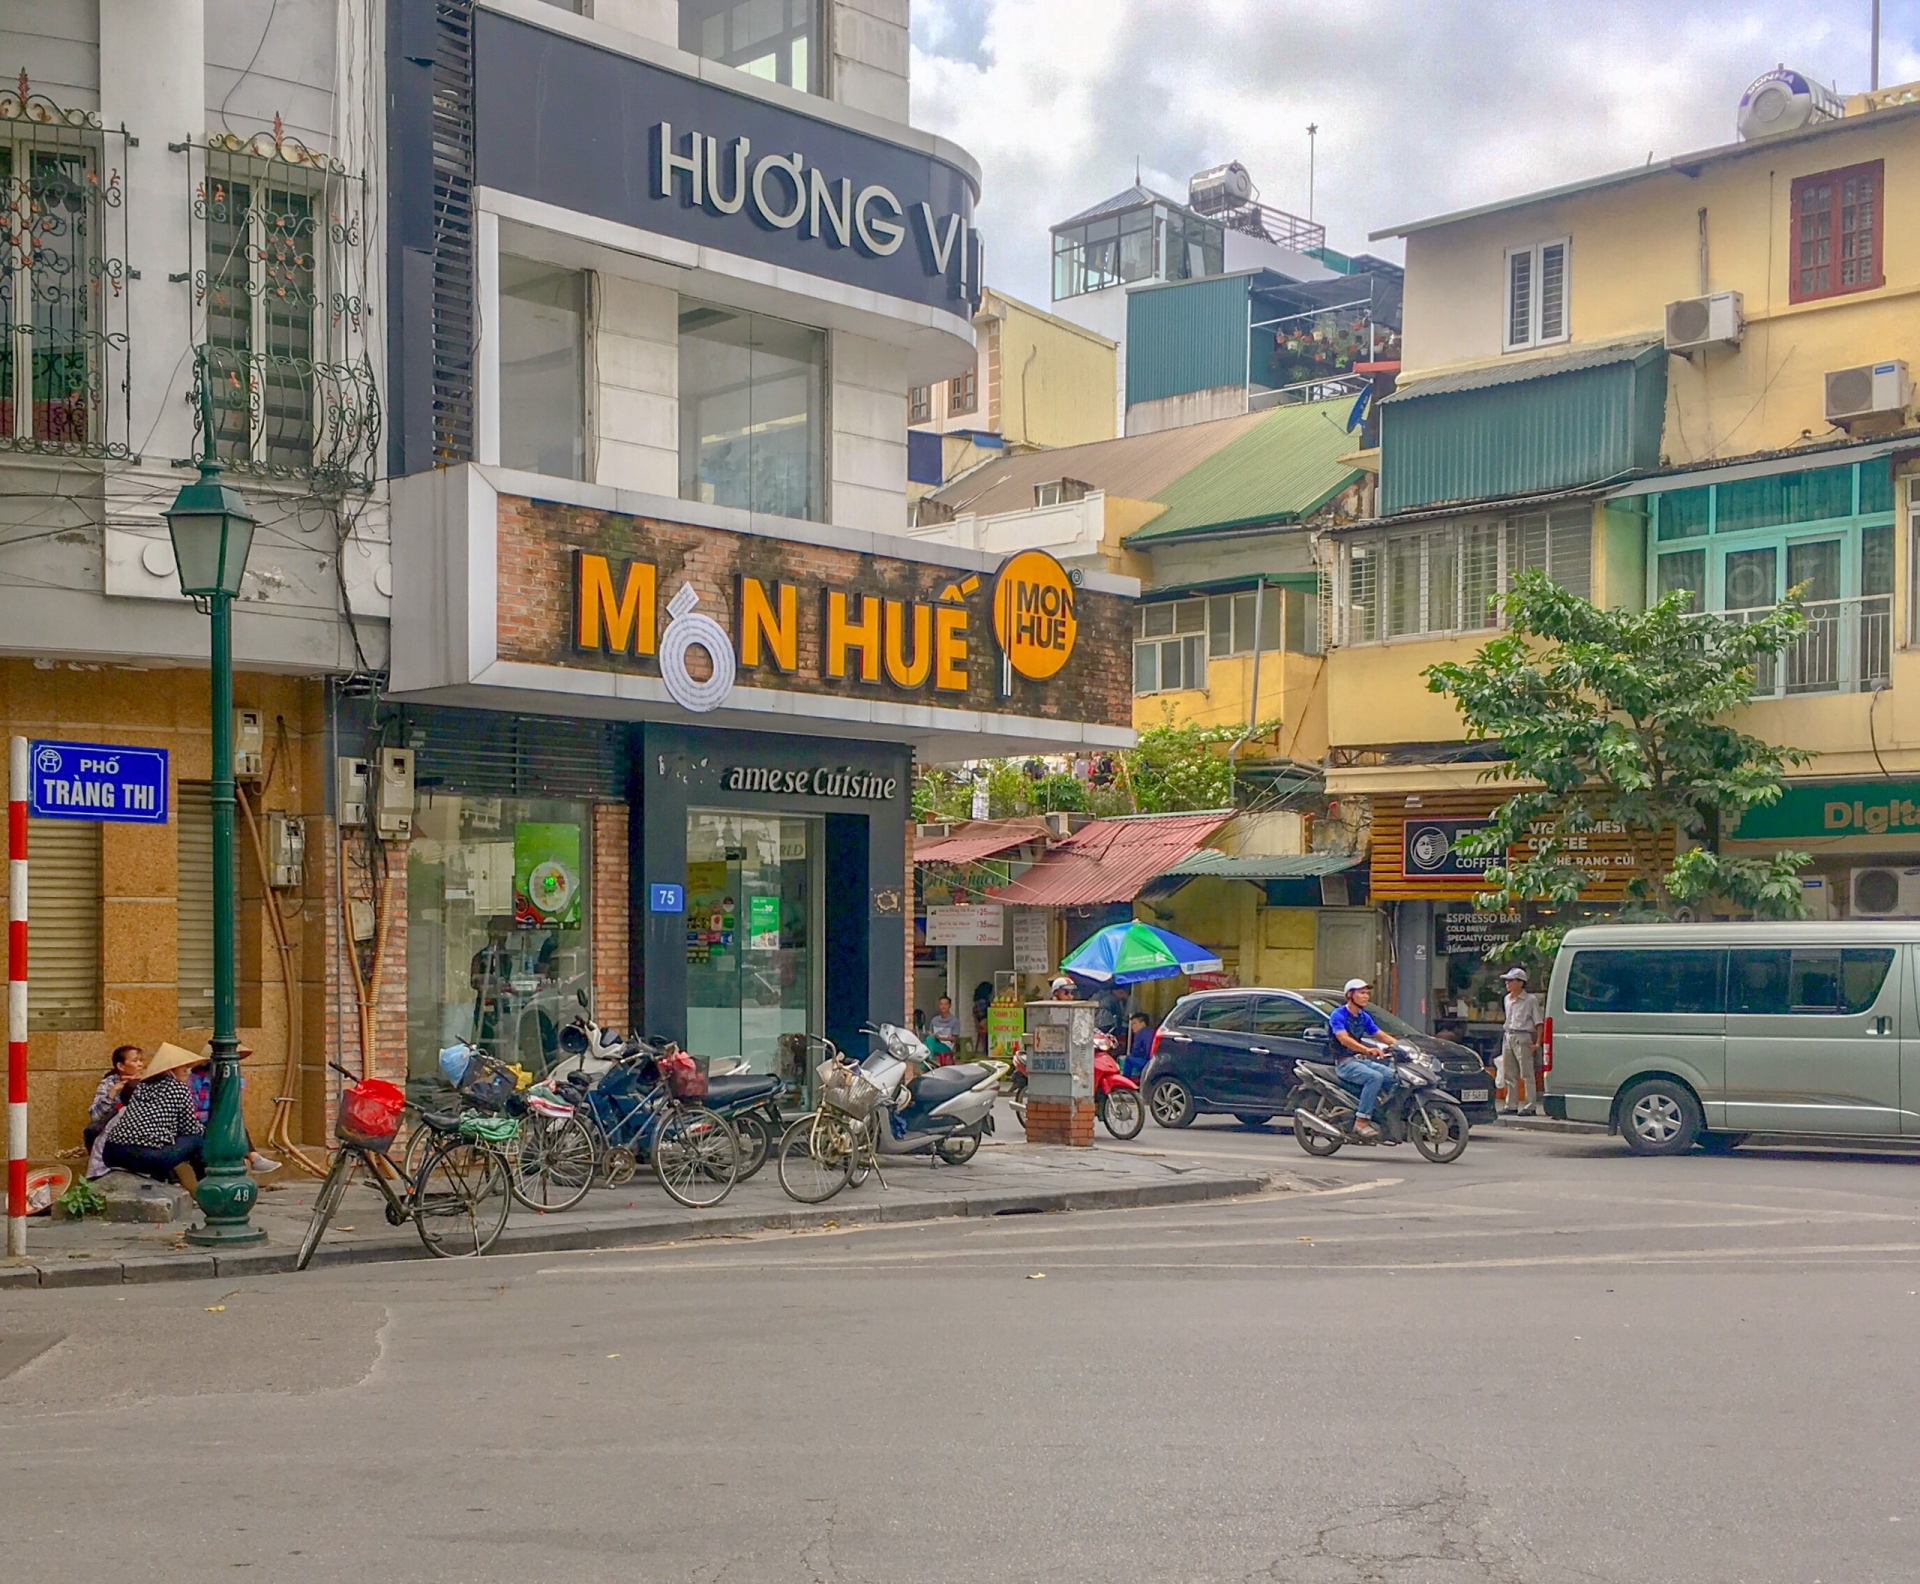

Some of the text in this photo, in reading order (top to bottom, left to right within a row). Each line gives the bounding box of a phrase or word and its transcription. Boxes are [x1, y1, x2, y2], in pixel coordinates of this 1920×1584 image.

[660, 120, 906, 257] HƯƠNG
[828, 574, 980, 691] HUẾ
[1016, 611, 1067, 651] HUE
[80, 755, 121, 774] PHỐ
[812, 765, 897, 800] Cuisine
[43, 774, 155, 810] TRÀNG THI
[1528, 836, 1588, 851] COFEE
[1456, 857, 1500, 869] COFFEE
[659, 890, 675, 905] 75
[1446, 913, 1522, 924] ESPRESSO BAR
[1447, 934, 1510, 942] SPECIALTY COFFEE
[234, 1188, 249, 1202] 48
